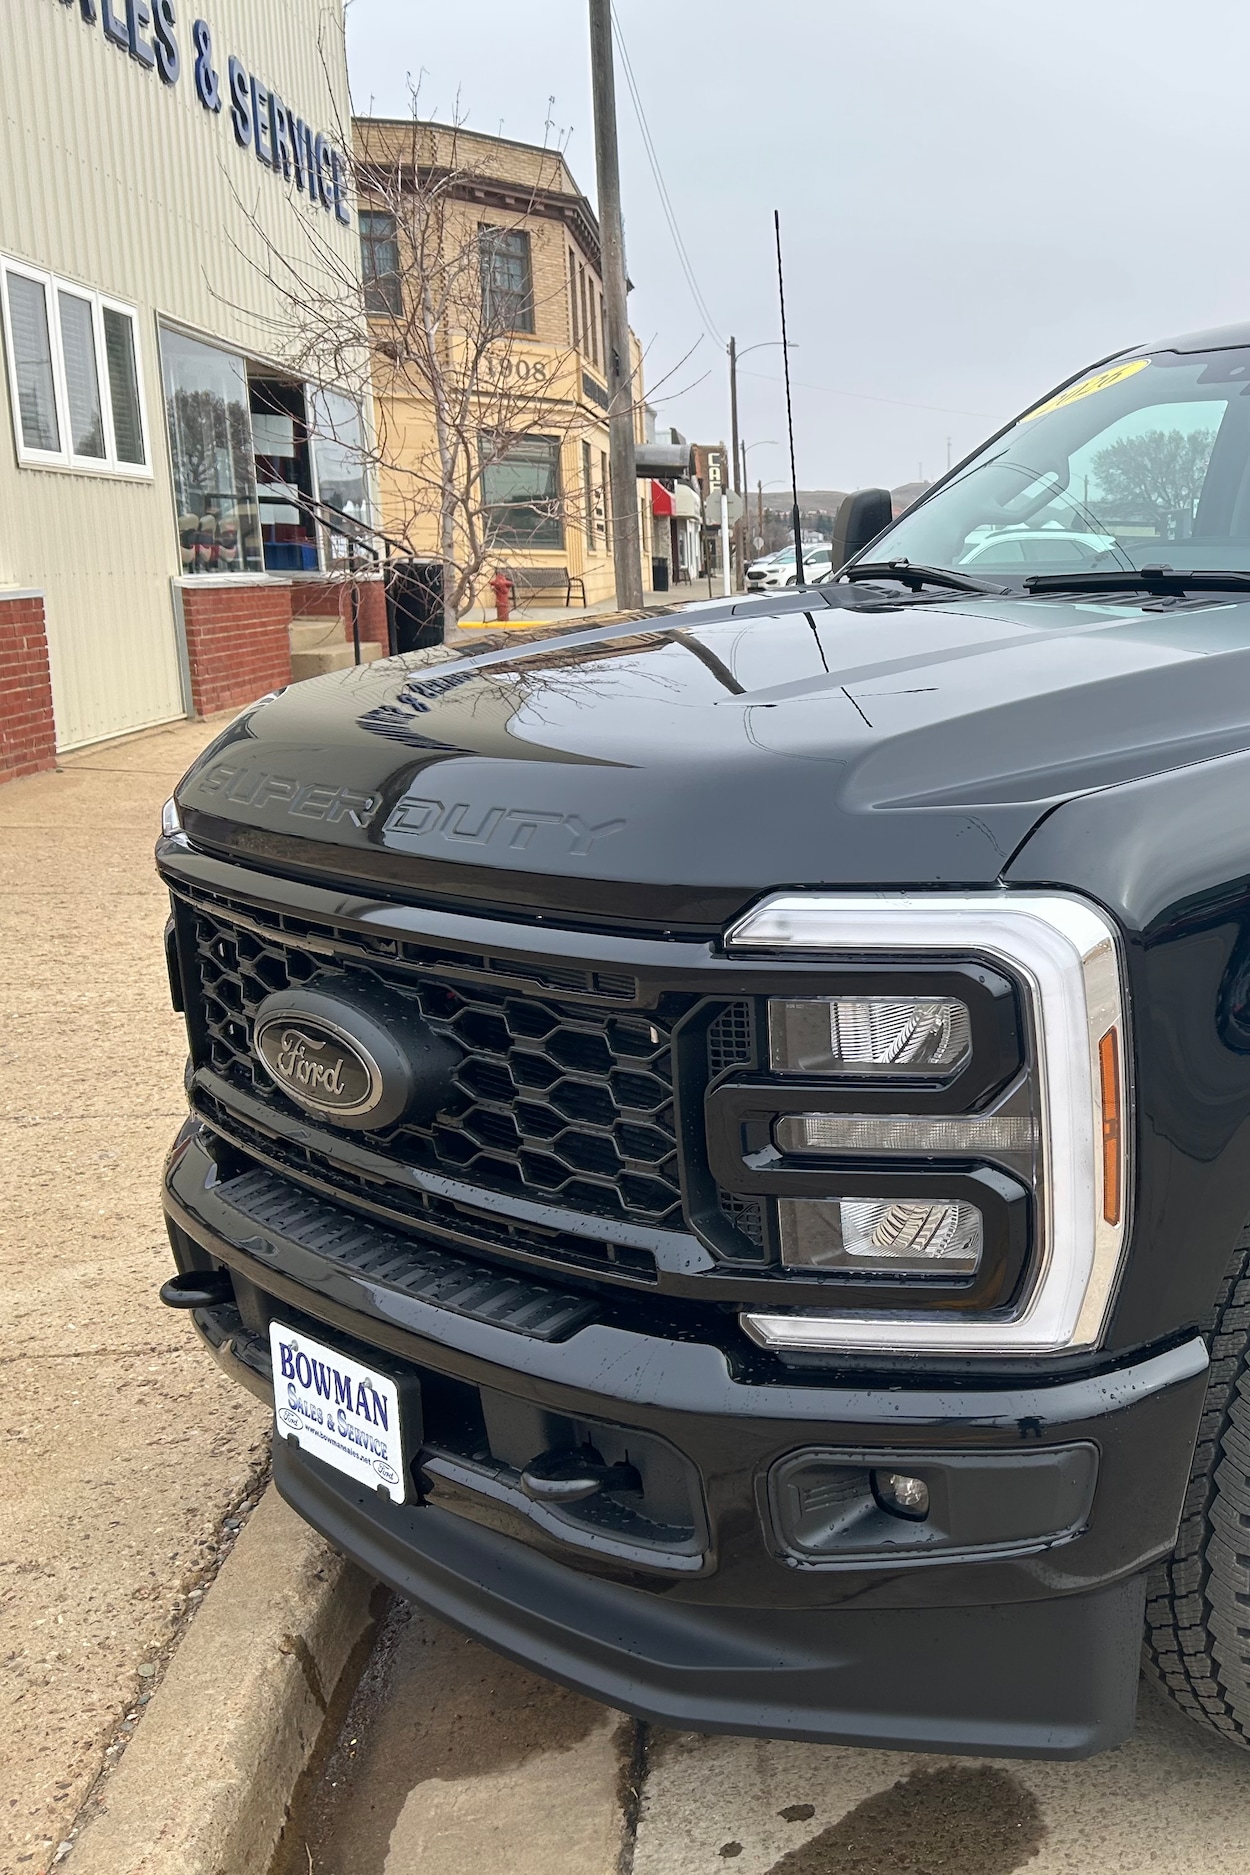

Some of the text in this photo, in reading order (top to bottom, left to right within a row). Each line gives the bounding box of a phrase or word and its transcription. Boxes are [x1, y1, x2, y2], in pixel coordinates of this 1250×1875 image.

[61, 0, 350, 226] LES & SERVICE
[707, 453, 721, 494] CAF
[199, 763, 627, 856] SUPER DUTY
[277, 1029, 345, 1096] Ford
[279, 1342, 388, 1432] BOWMAN
[287, 1382, 388, 1460] SALES & SERVICE
[305, 1424, 371, 1466] www.bowmansales.net
